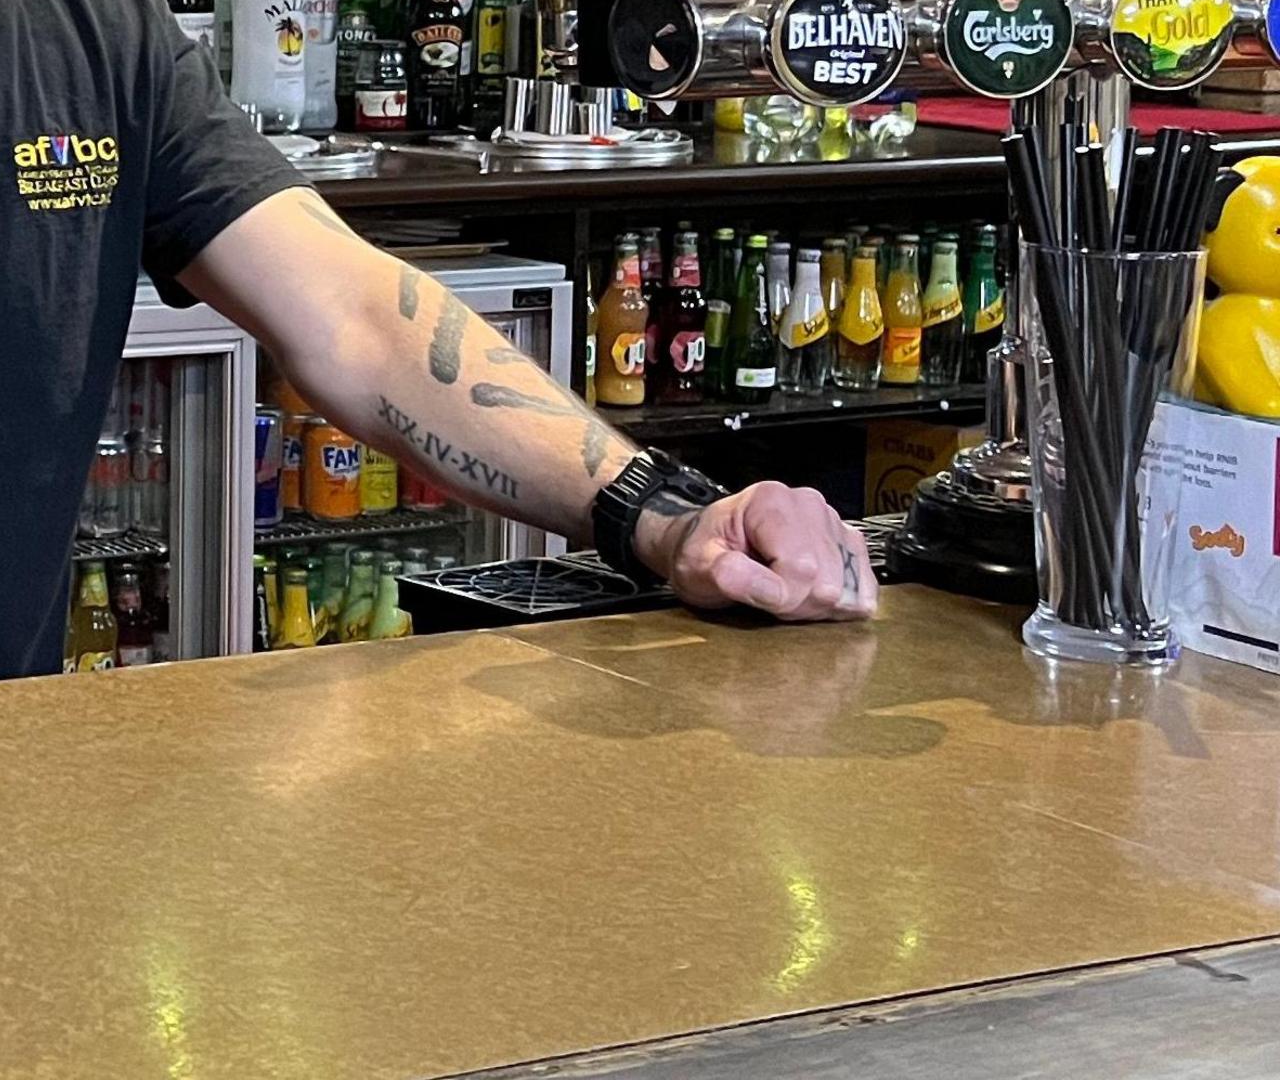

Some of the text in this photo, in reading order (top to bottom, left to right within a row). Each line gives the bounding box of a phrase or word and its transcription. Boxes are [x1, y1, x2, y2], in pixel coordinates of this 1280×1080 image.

[789, 11, 903, 50] BELHAVEN
[963, 10, 1053, 52] Carlsberg
[1150, 2, 1210, 45] Gold
[813, 60, 878, 84] BEST
[13, 134, 120, 167] afvbc
[323, 444, 362, 468] FAN
